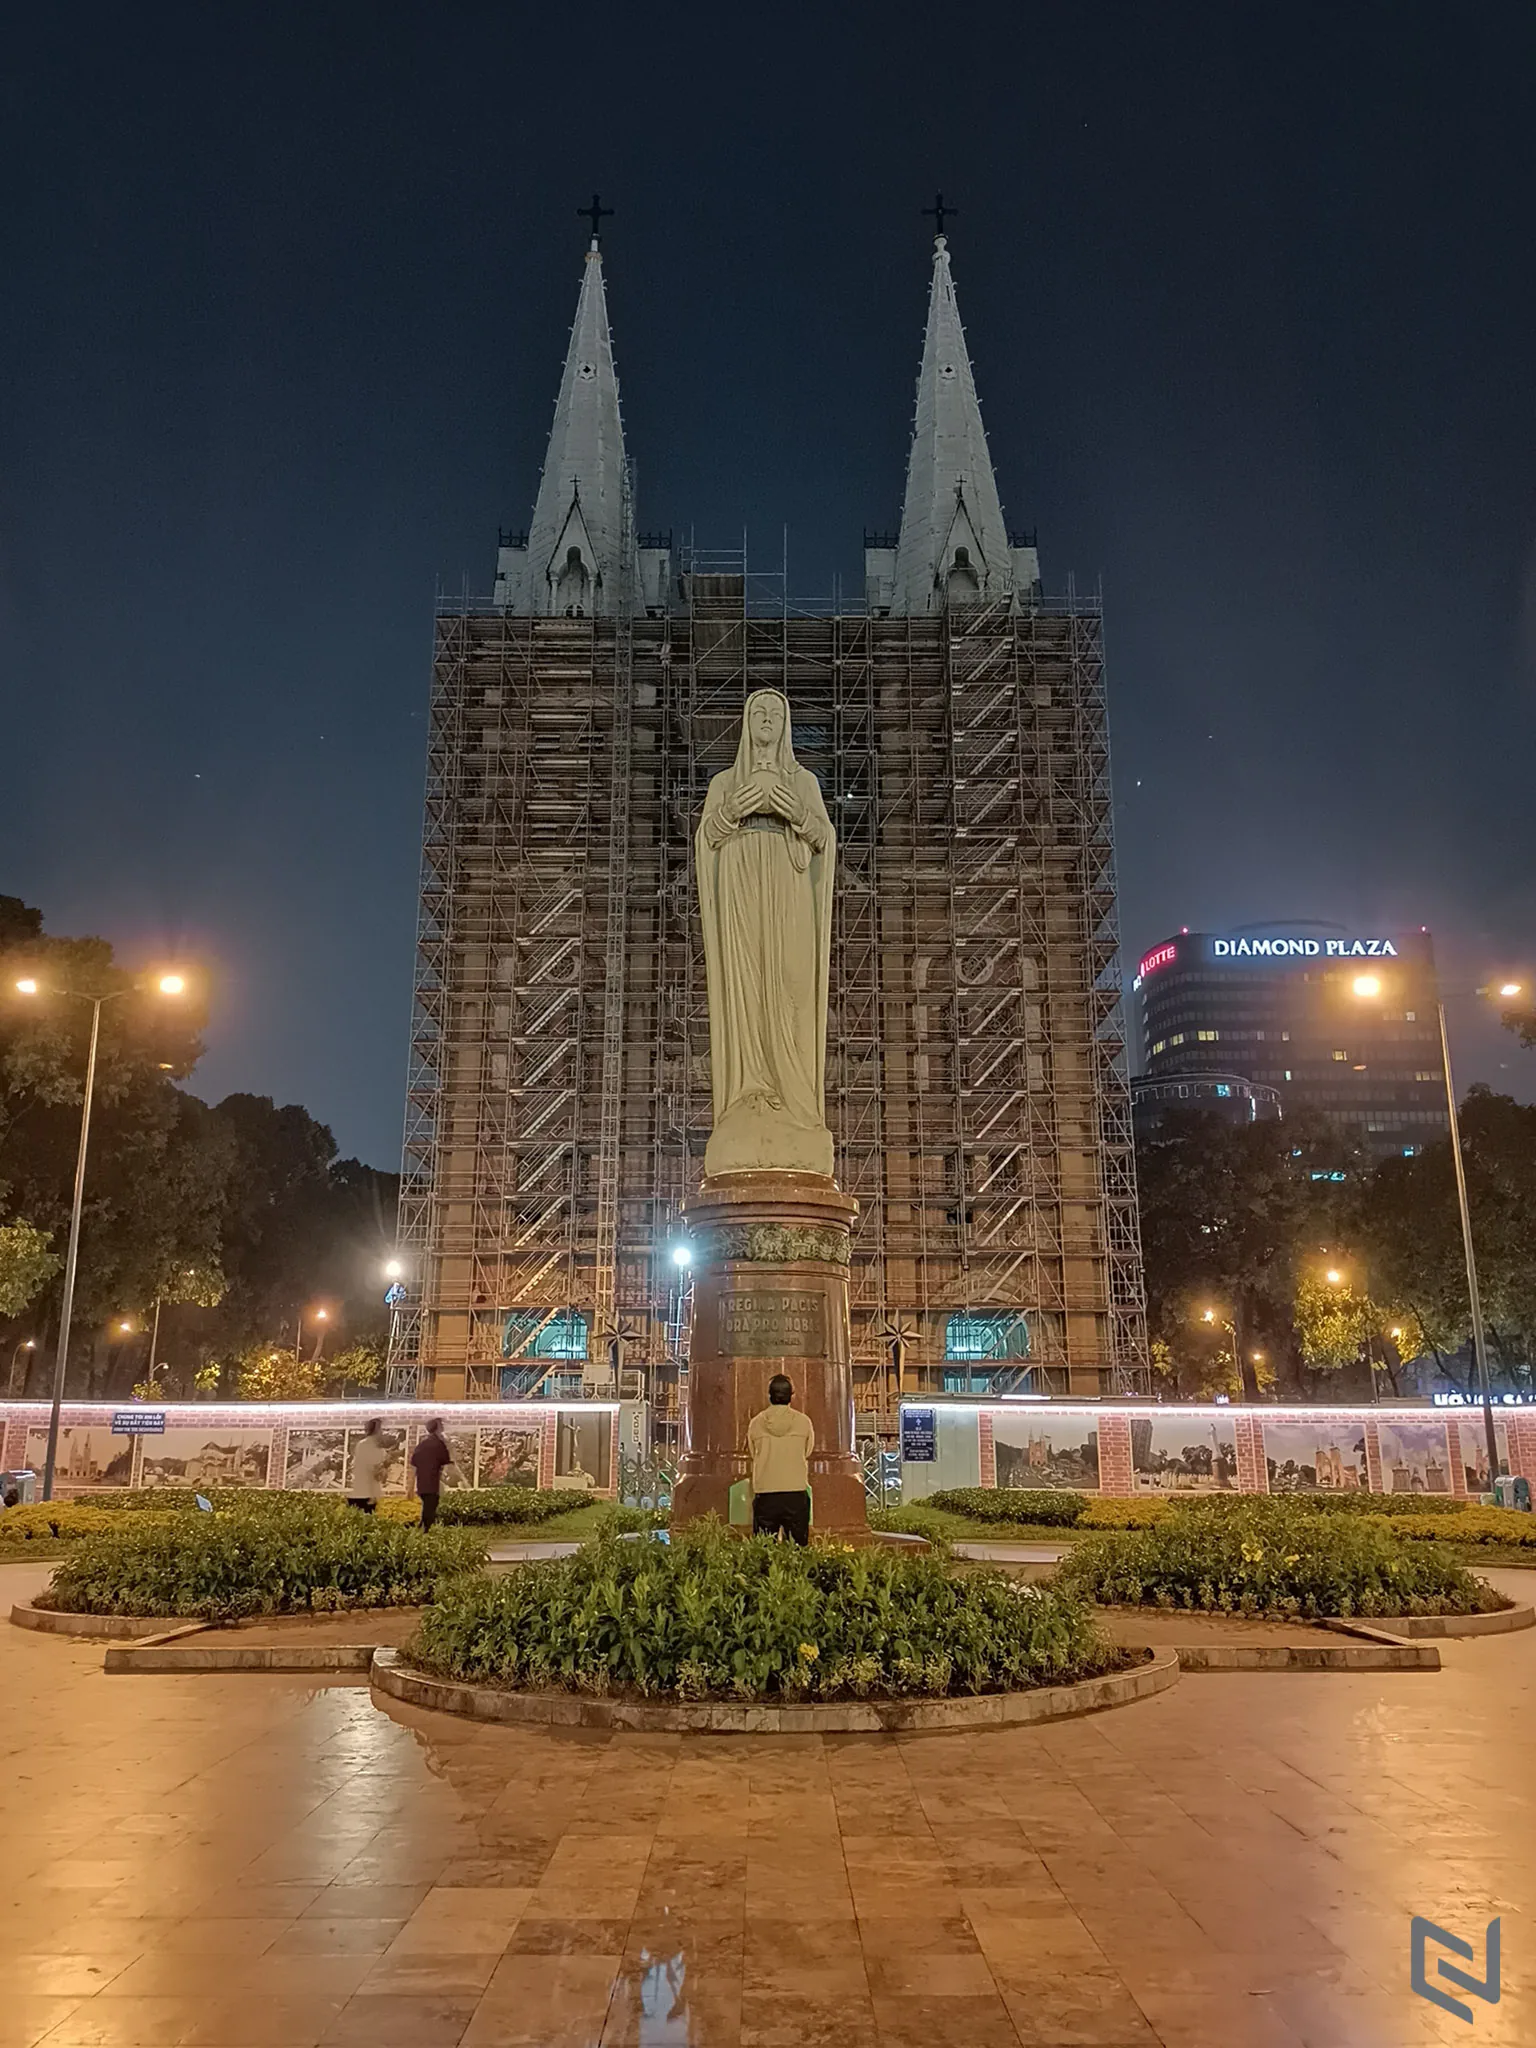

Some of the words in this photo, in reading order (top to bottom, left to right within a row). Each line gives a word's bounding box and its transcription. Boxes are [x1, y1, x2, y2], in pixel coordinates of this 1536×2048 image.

[1214, 938, 1320, 956] DIAMOND
[1325, 940, 1398, 956] PLAZA
[1145, 946, 1176, 972] LOTTE
